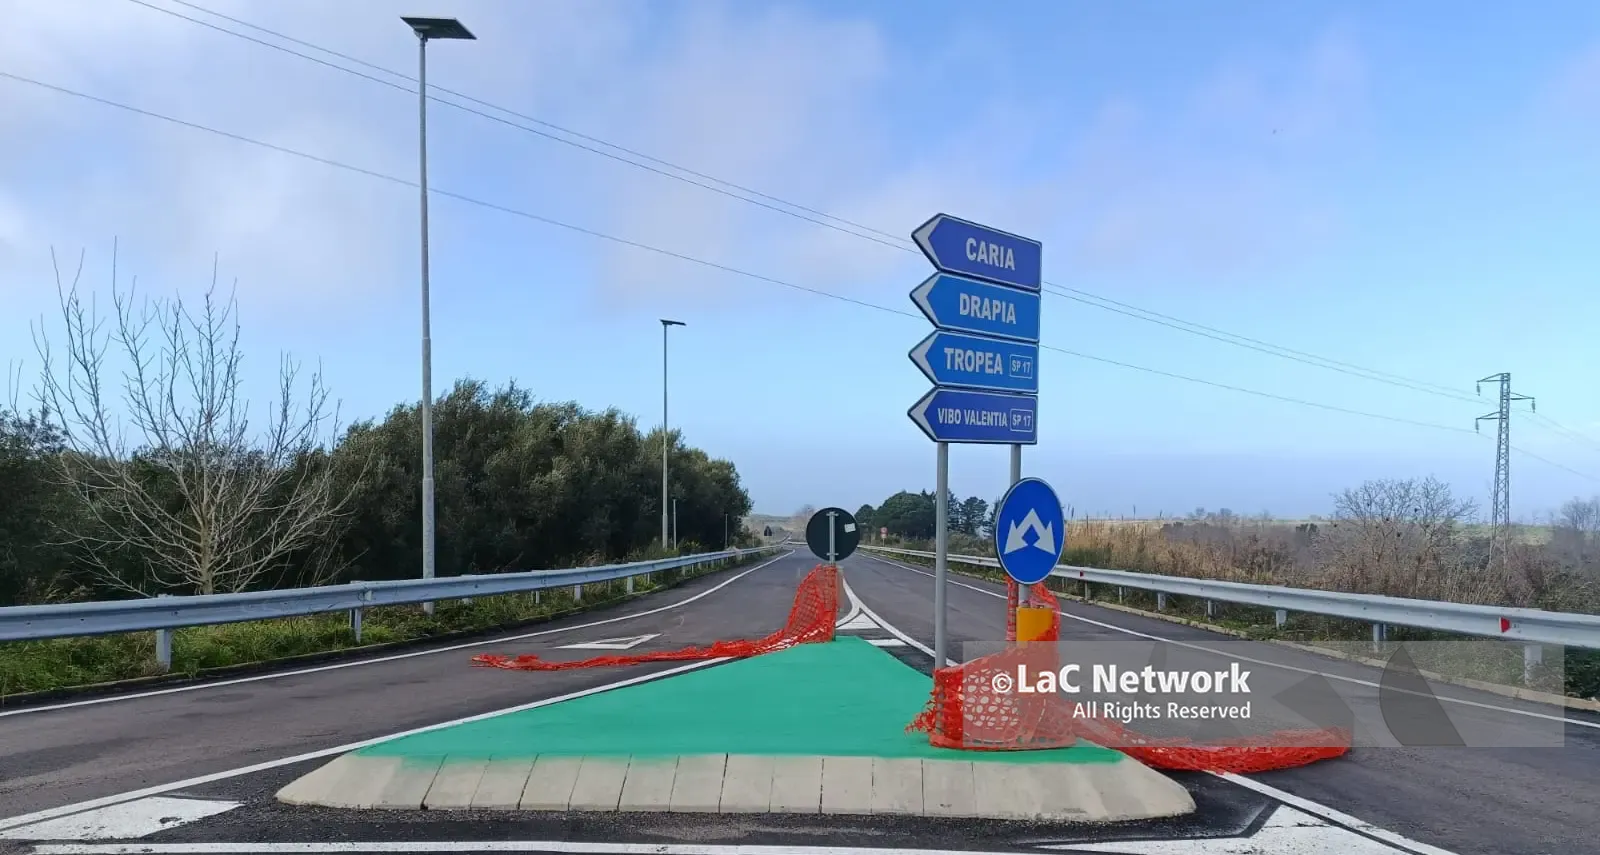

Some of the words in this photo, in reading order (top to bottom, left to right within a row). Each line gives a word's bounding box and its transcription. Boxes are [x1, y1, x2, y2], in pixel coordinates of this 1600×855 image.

[966, 237, 1016, 271] CARIA
[959, 292, 1017, 325] DRAPIA
[944, 347, 1003, 375] TROPEA
[1011, 359, 1022, 373] SP
[1022, 360, 1031, 374] 17
[937, 407, 962, 425] VIBO
[964, 409, 1008, 427] VALENTIA
[1012, 414, 1022, 426] SP
[1022, 415, 1032, 427] 17
